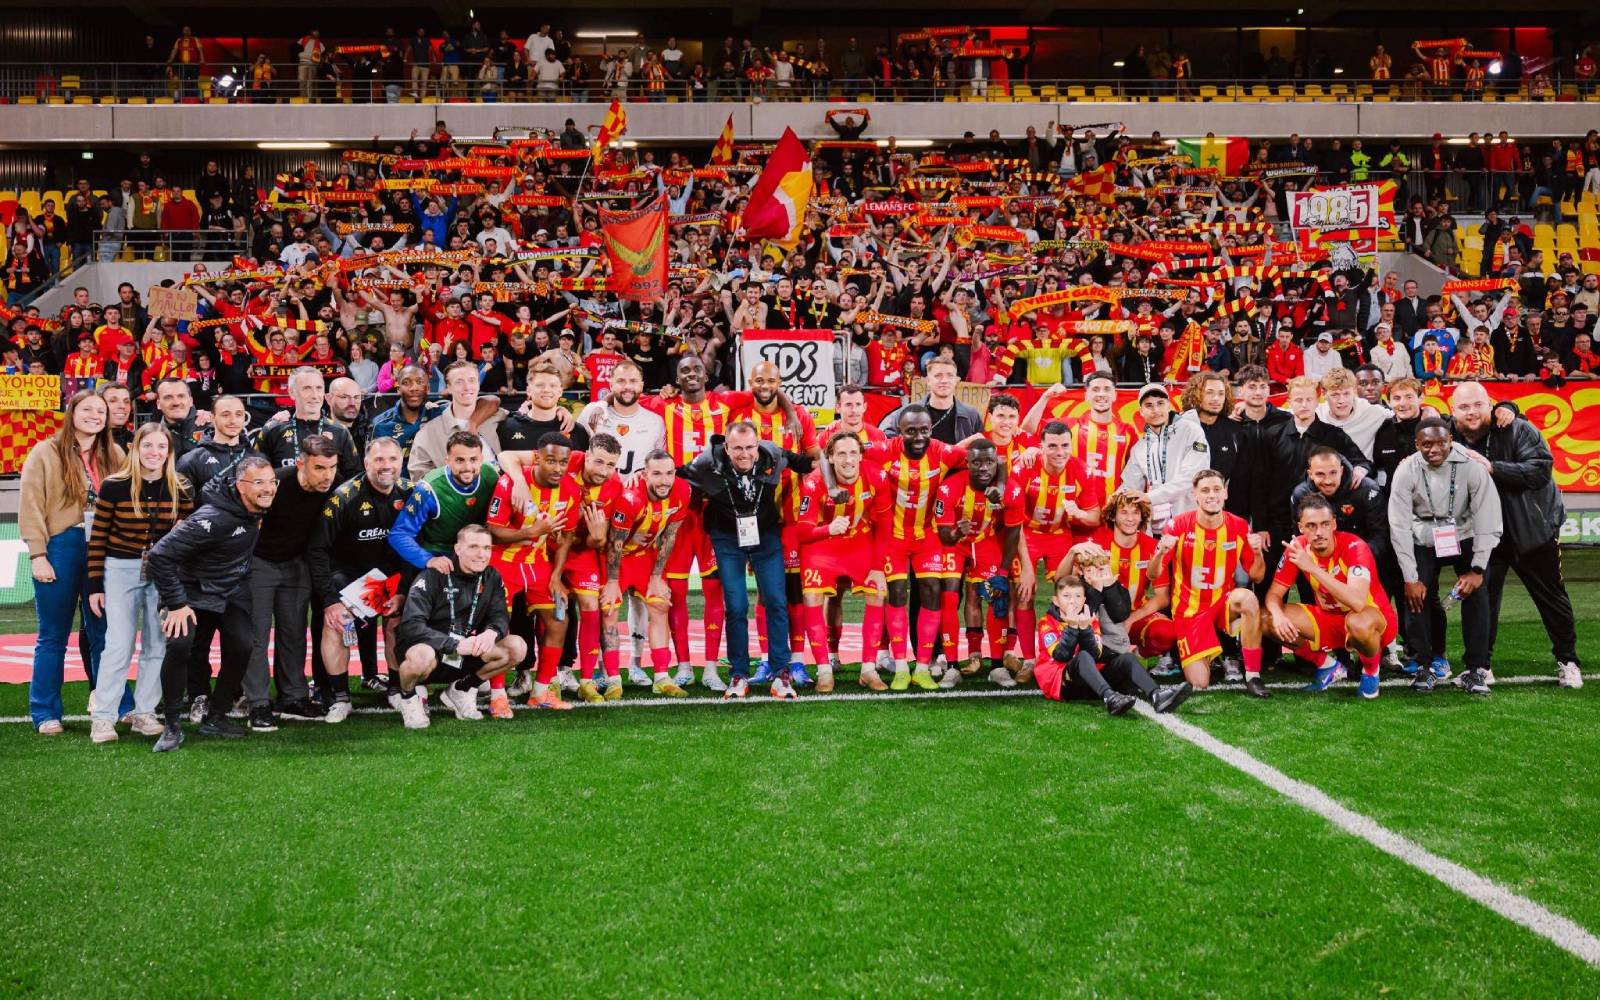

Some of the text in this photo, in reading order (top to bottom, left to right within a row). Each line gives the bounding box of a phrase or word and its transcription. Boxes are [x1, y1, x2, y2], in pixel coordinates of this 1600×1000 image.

[903, 203, 914, 211] FC
[1295, 192, 1369, 225] 1985
[191, 270, 232, 282] SANG
[1, 376, 57, 388] YOHOU
[37, 389, 57, 398] TON
[804, 570, 823, 587] 24
